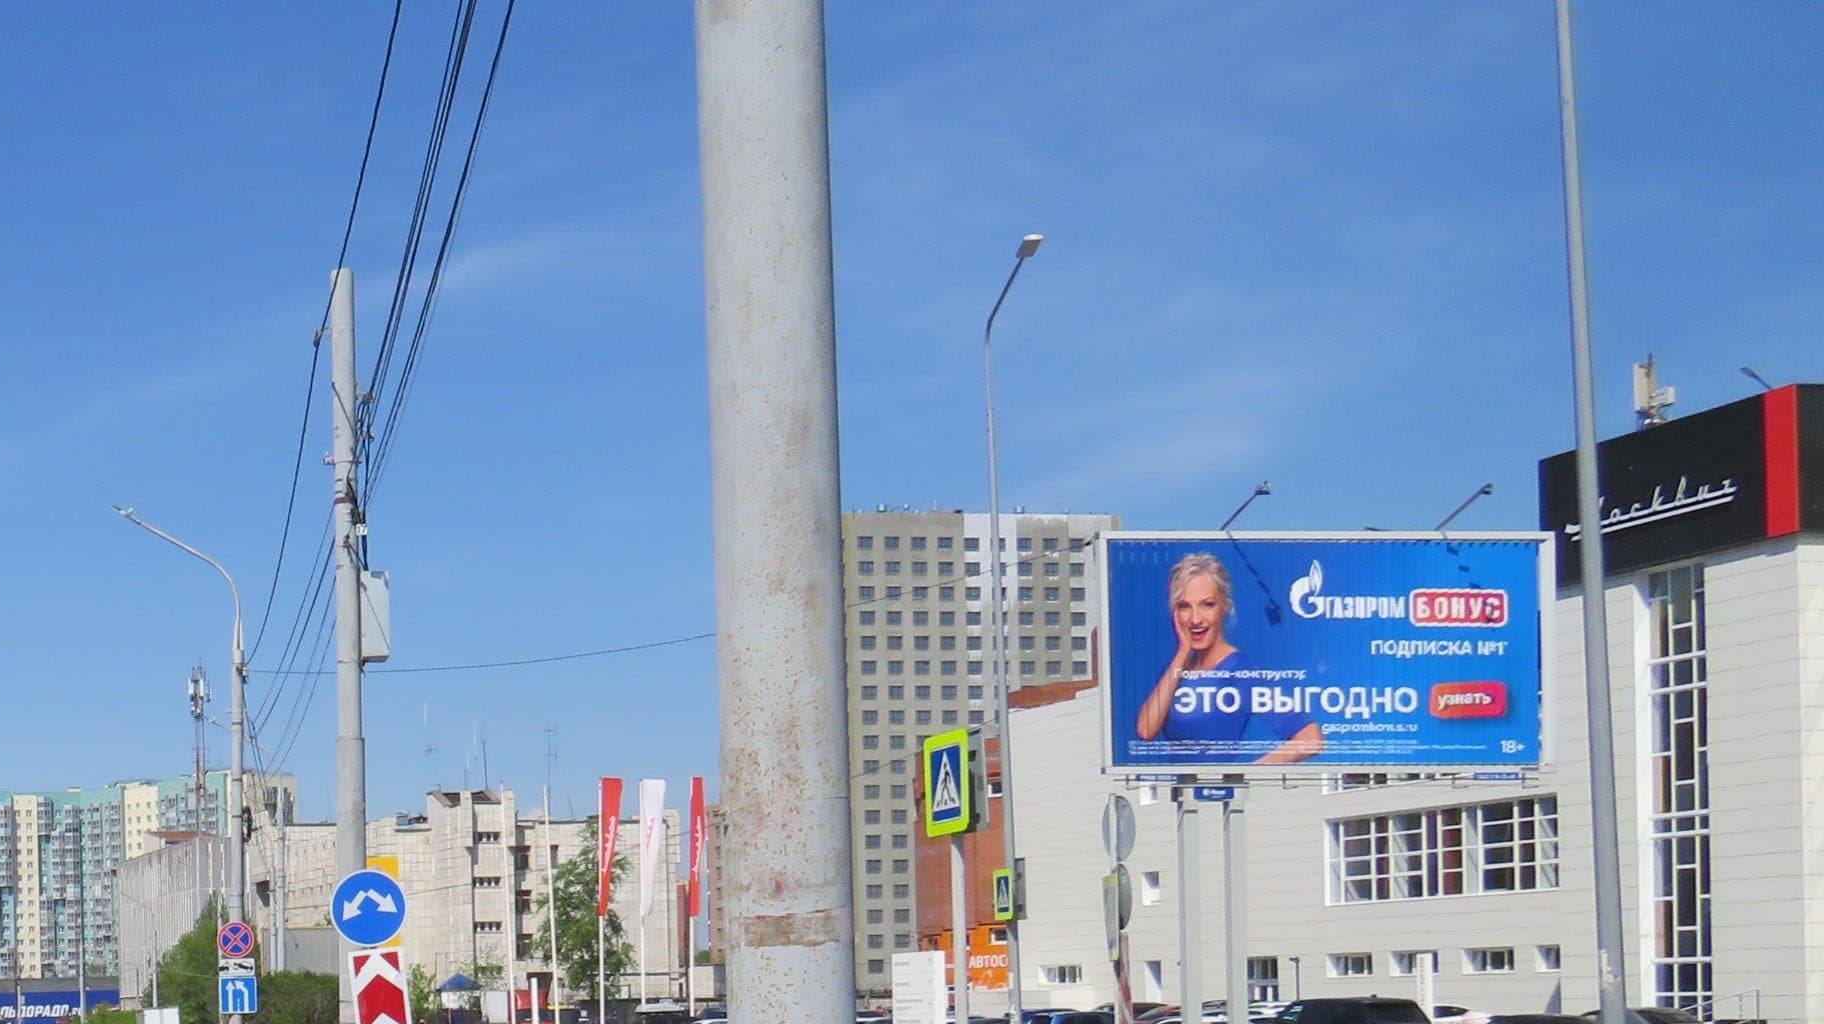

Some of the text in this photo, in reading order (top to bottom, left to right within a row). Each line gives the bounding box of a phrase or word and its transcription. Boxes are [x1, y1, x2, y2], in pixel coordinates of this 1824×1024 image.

[1325, 596, 1501, 619] ГАЗПРОМ БОНУС
[1370, 639, 1473, 658] ПОДПИСКА
[1174, 686, 1419, 719] ЭТО ВЫГОДНО
[1438, 692, 1492, 711] узнать
[1499, 739, 1526, 754] 18+
